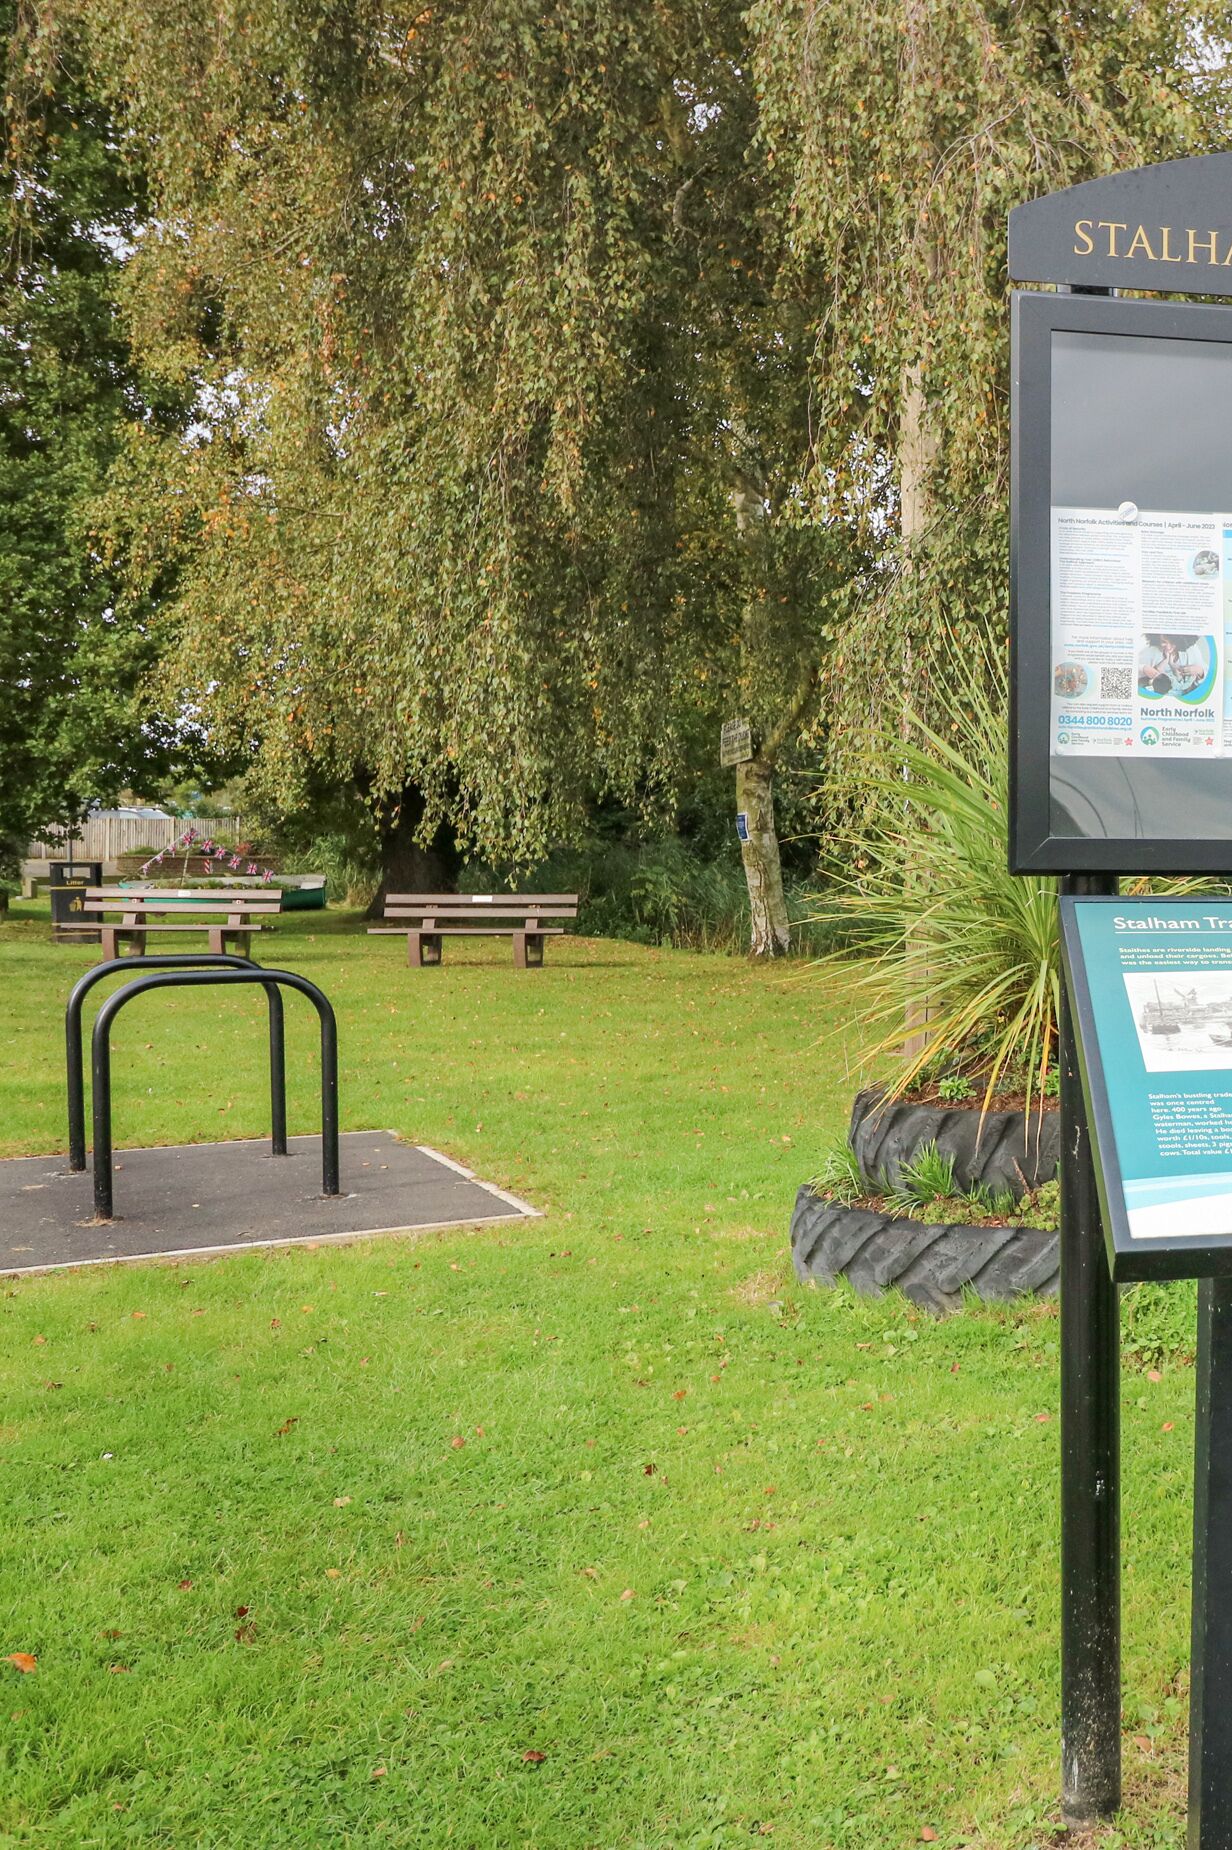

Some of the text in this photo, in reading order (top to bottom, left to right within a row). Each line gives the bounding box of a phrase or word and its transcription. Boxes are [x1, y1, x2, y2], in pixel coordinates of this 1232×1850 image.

[1140, 708, 1172, 717] North
[1174, 708, 1214, 718] Norfolk
[1058, 716, 1084, 725] 0344
[1087, 716, 1105, 725] 800
[1108, 717, 1132, 726] 8020
[1113, 917, 1199, 929] Stalham
